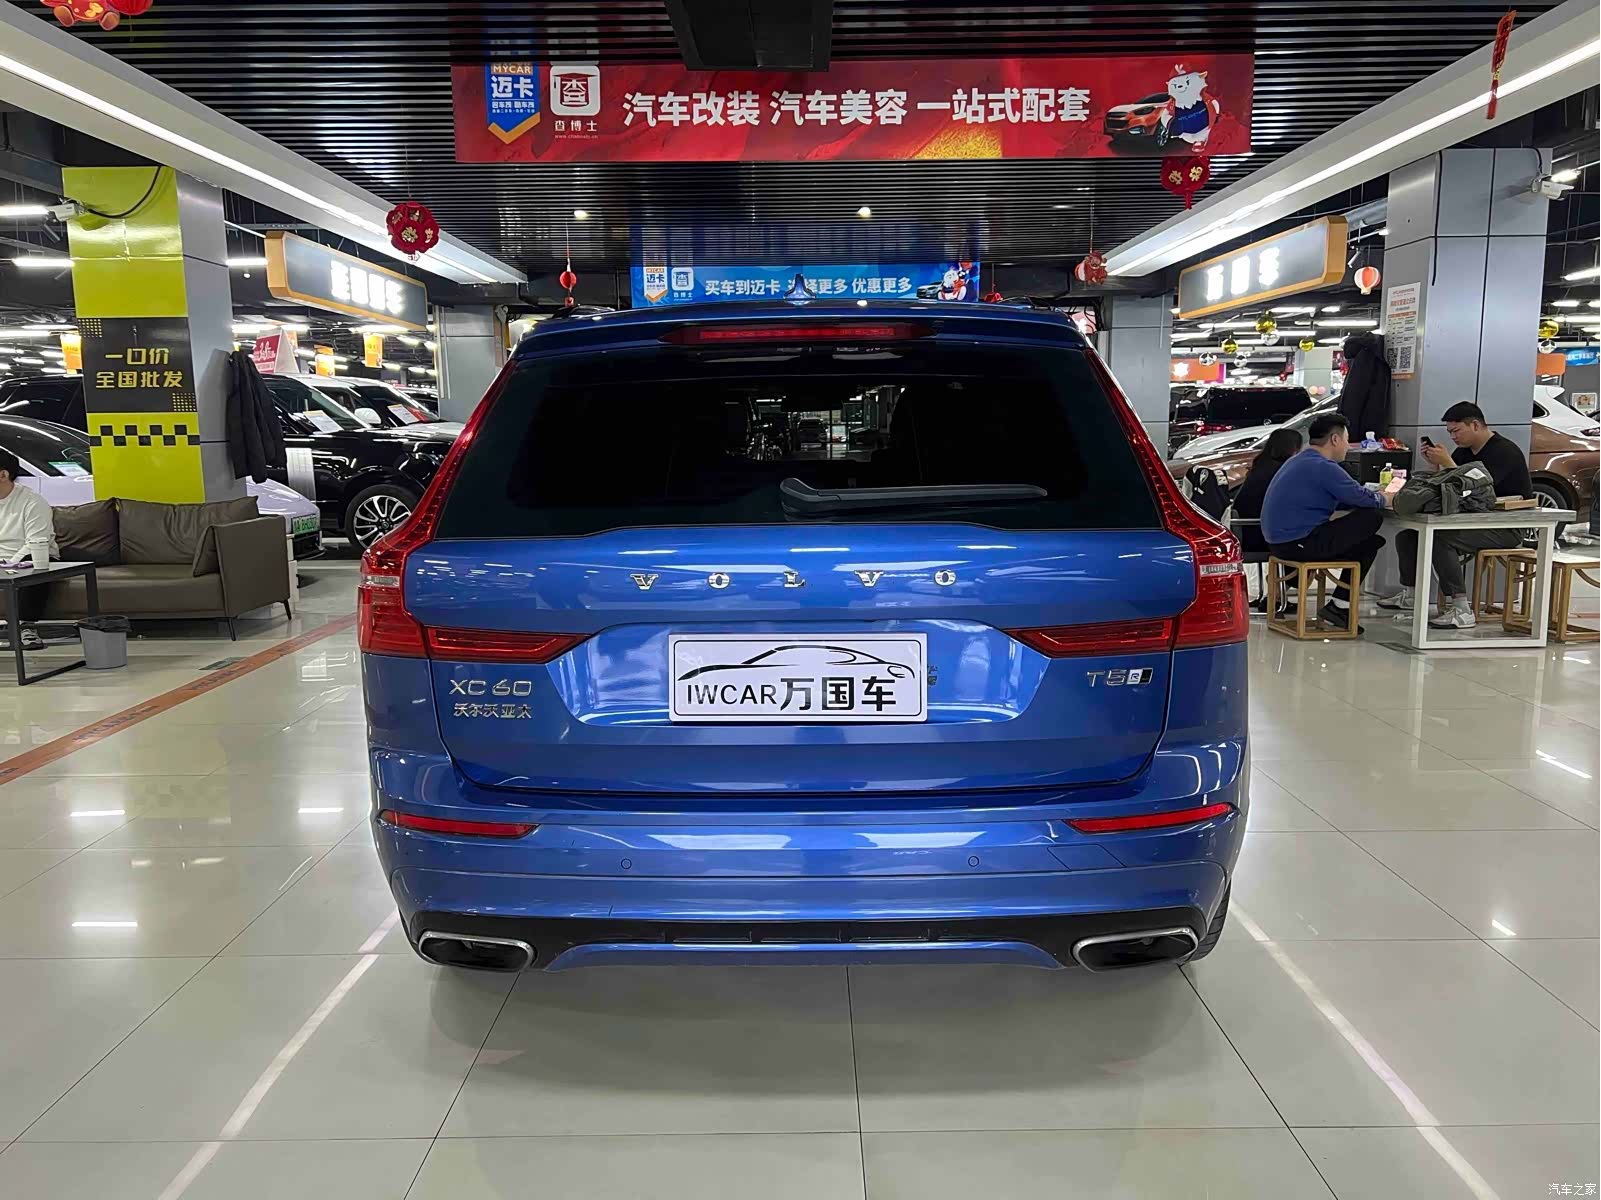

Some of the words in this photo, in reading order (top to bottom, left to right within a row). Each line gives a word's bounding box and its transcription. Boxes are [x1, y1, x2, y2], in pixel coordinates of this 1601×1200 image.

[492, 65, 532, 74] MYCAR
[491, 76, 534, 98] 迈卡
[622, 91, 760, 127] 汽车改装
[769, 89, 908, 126] 汽车美容
[917, 87, 1091, 125] 一站式配套
[554, 120, 598, 132] 查博士
[646, 273, 665, 283] 迈卡
[705, 279, 781, 296] 买车到迈卡
[852, 277, 912, 294] 优惠更多
[105, 347, 170, 365] 一口价
[96, 371, 183, 389] 全国批发
[630, 569, 957, 591] VOLVO
[1087, 669, 1127, 687] T5
[453, 702, 533, 719] 沃尔沃亚太
